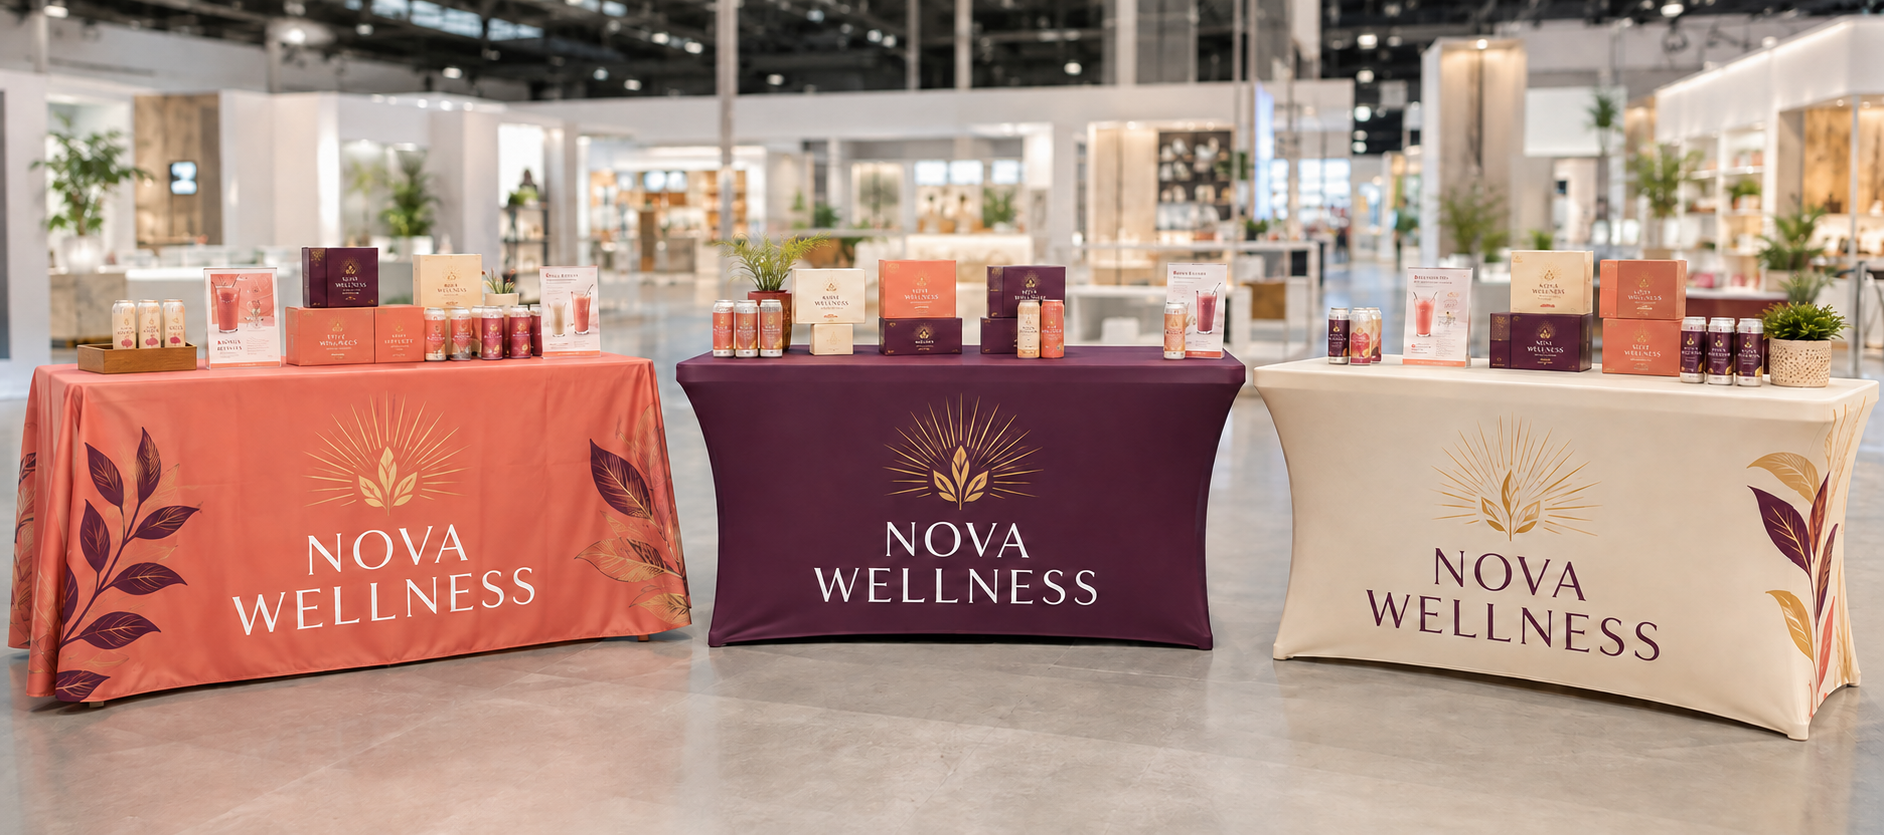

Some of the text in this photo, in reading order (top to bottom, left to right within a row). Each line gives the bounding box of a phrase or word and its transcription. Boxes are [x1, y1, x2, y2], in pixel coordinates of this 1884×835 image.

[308, 524, 468, 575] NOVA
[886, 521, 1030, 558] NOVA
[813, 567, 1098, 606] WELLNESS
[1434, 547, 1587, 601] NOVA
[232, 567, 536, 636] WELLNESS
[1366, 589, 1661, 662] WELLNESS
